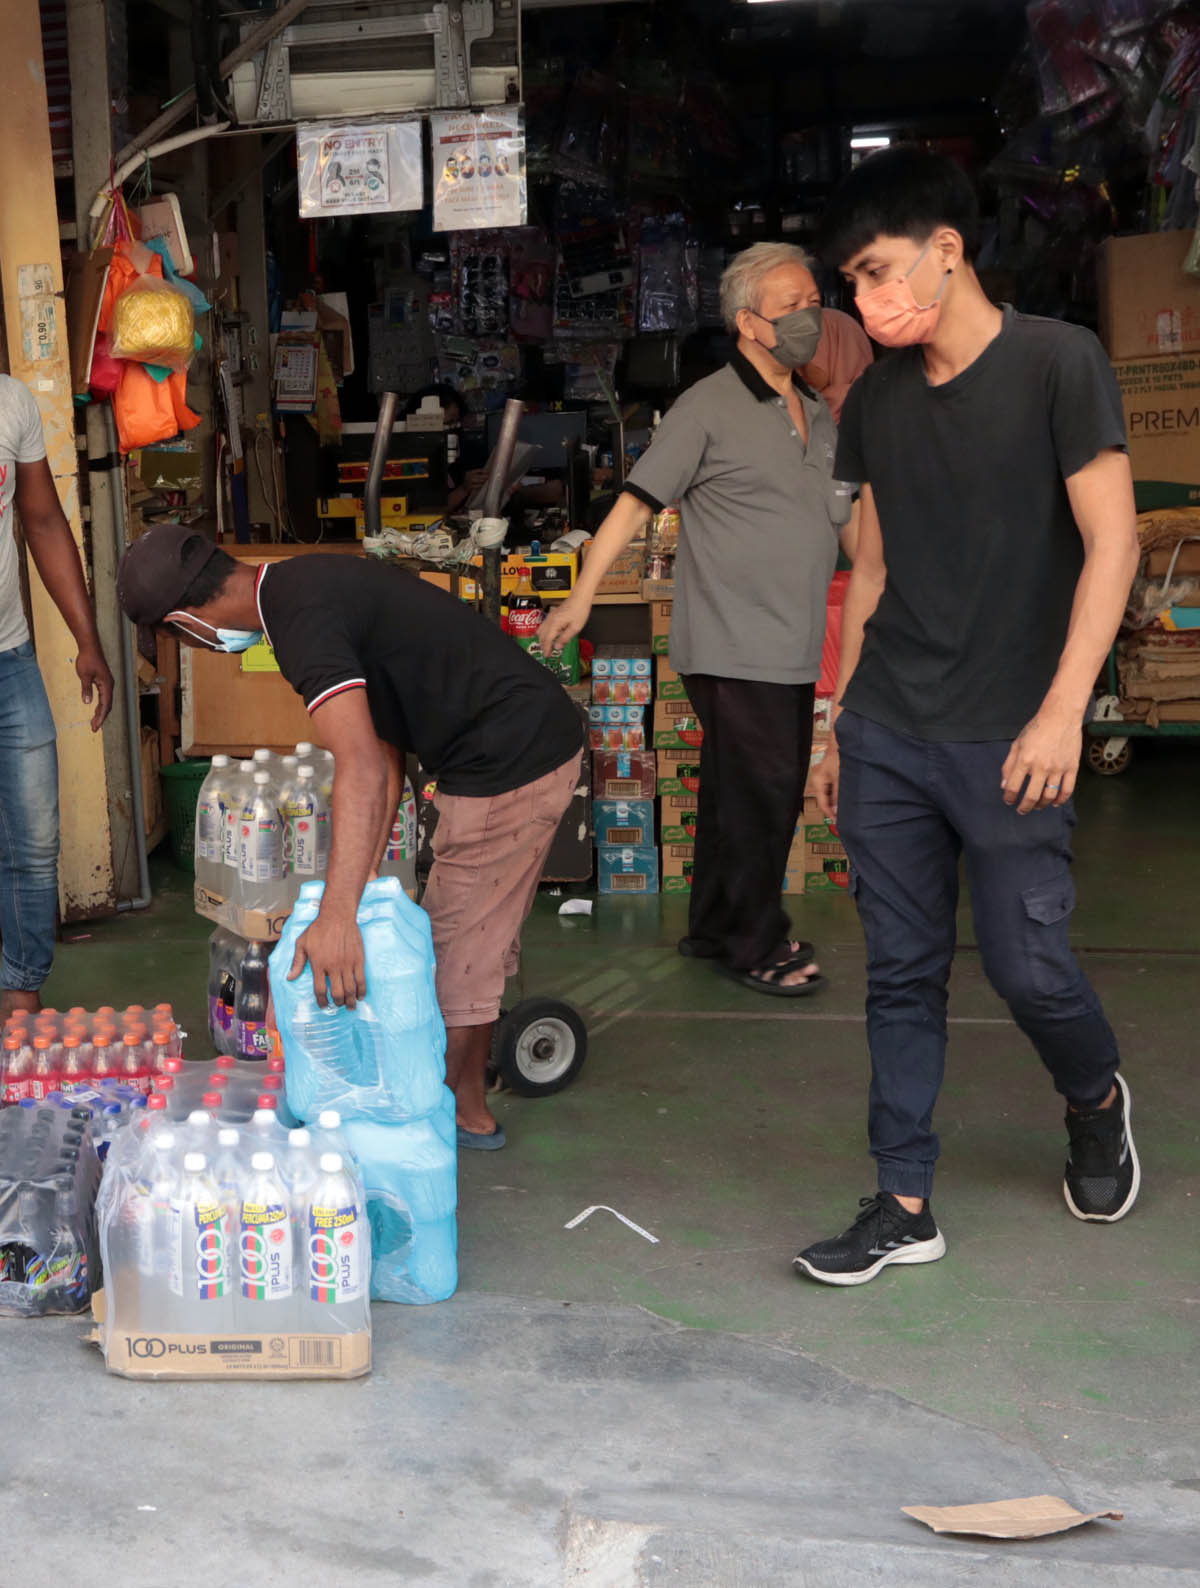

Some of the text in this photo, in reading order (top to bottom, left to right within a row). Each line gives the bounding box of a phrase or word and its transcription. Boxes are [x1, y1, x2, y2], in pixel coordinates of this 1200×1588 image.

[324, 139, 342, 150] NO
[38, 322, 47, 341] 0.90
[266, 917, 286, 936] 10
[315, 1216, 334, 1228] FREE
[239, 1230, 269, 1288] 100
[270, 1252, 280, 1286] PLUS
[308, 1233, 339, 1289] 100
[341, 1254, 351, 1288] PLUS
[125, 1337, 254, 1358] 100 PLUS ORIGINAL
